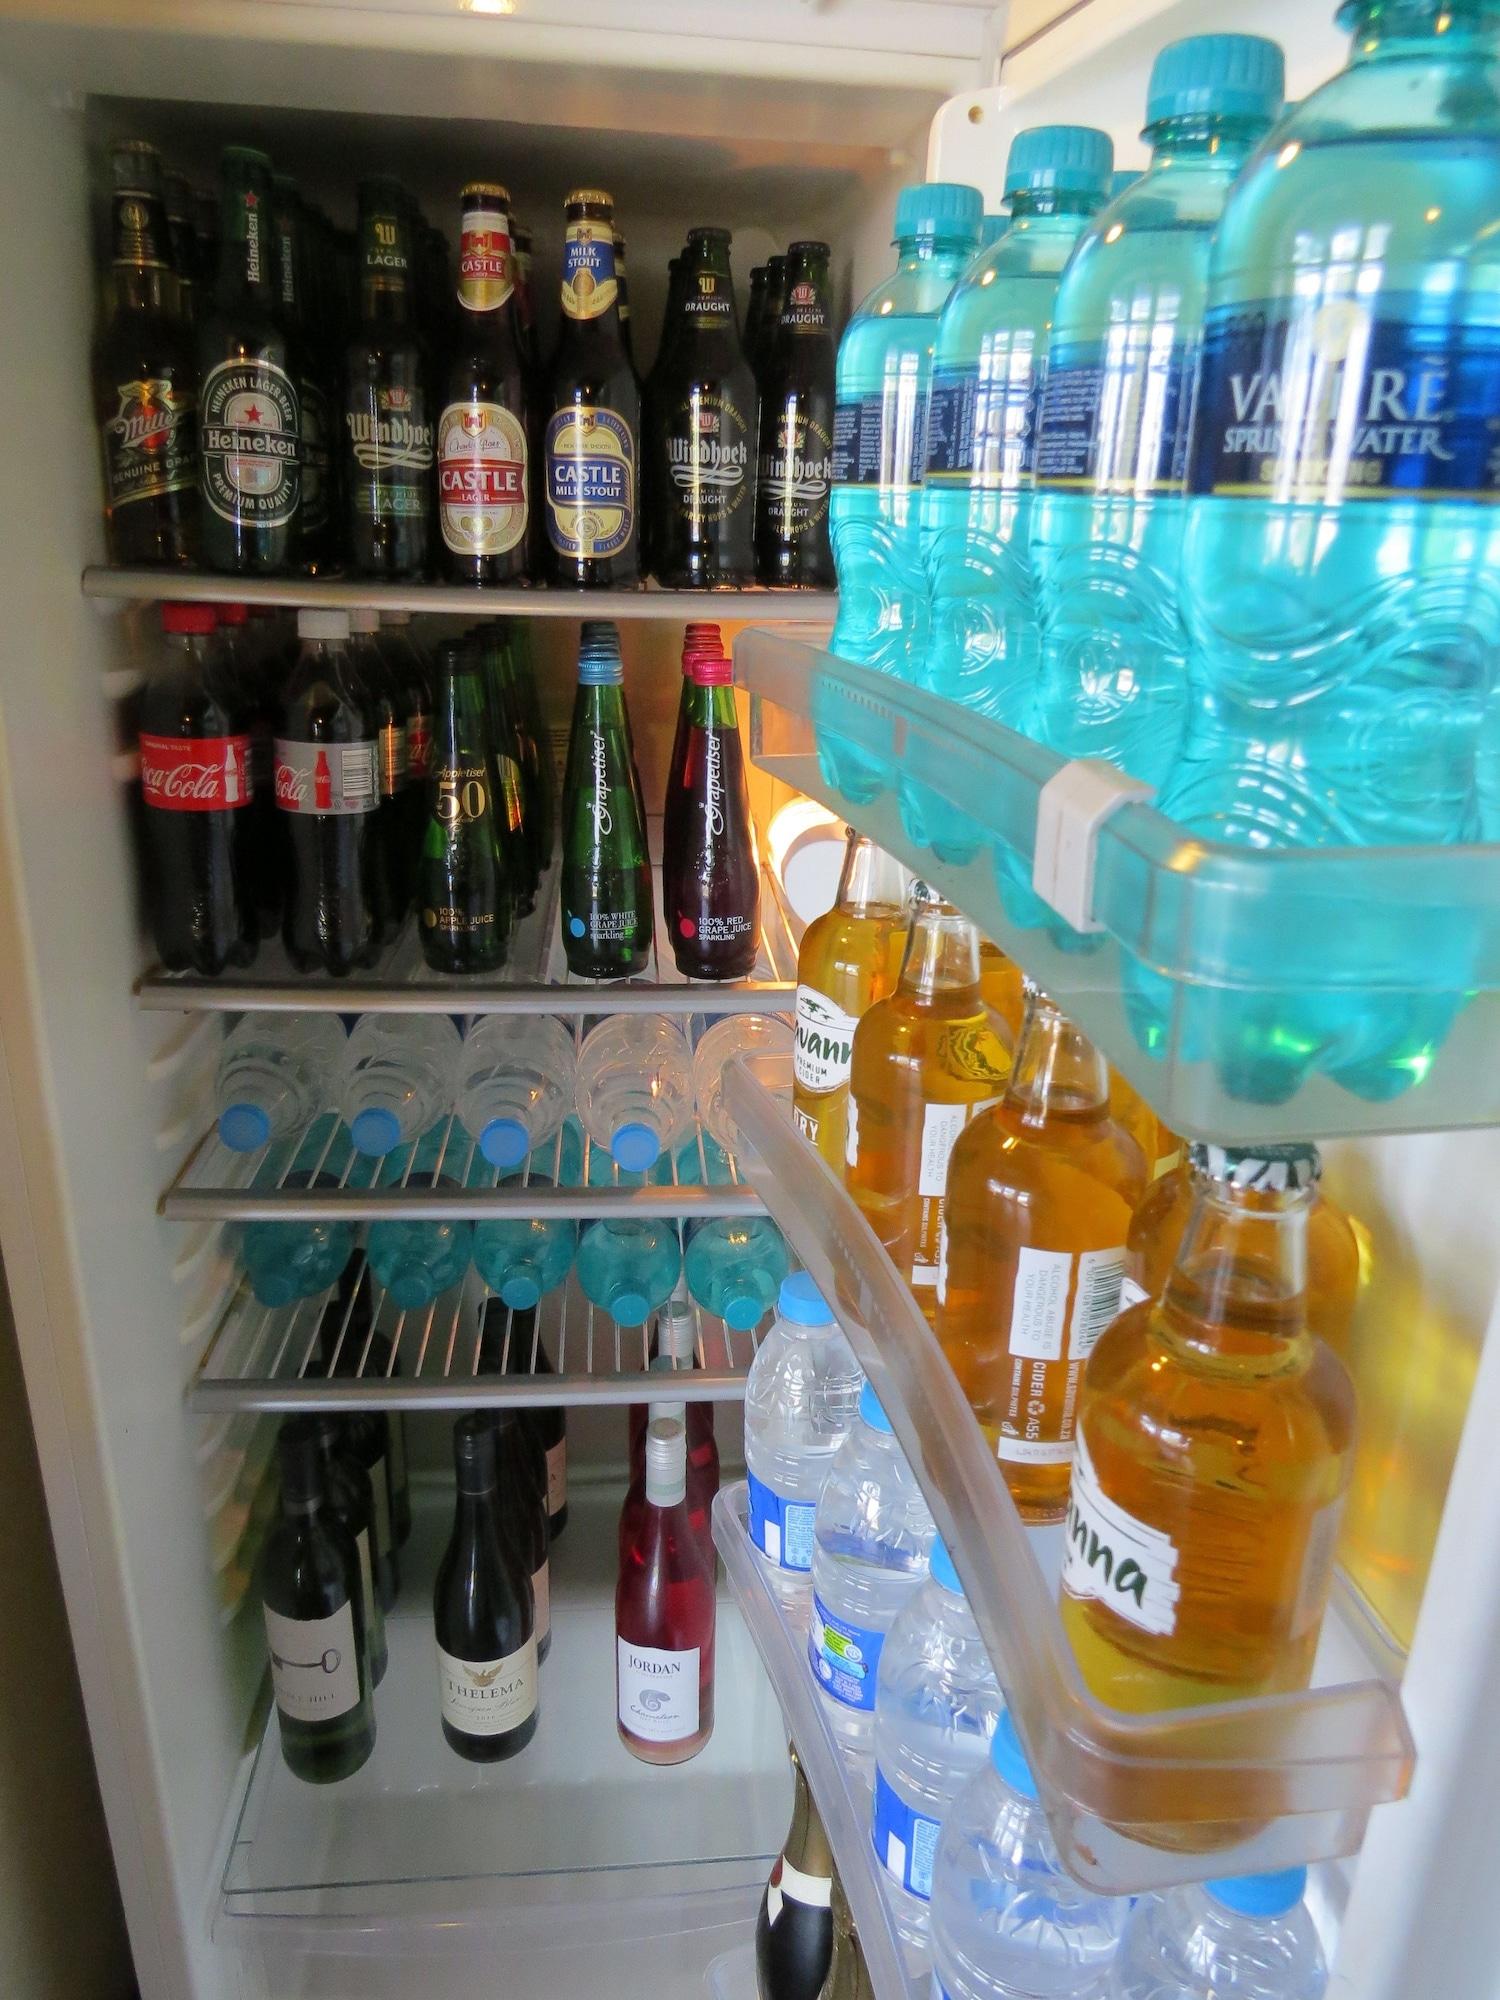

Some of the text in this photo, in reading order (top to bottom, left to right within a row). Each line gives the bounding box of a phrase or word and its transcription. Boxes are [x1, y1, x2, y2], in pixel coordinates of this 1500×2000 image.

[246, 213, 260, 283] Heineken
[570, 247, 597, 258] MILK
[367, 255, 408, 270] LAGER
[461, 259, 503, 273] CASTLE
[567, 257, 601, 269] STOUT
[684, 302, 731, 312] DRAUGHT
[781, 314, 825, 325] DRAUGHT
[1230, 355, 1450, 423] VARÉ
[212, 376, 293, 422] HEINEKEN LAGER BEER
[689, 396, 724, 410] PEMIUM
[777, 413, 810, 427] PRIUM
[346, 412, 434, 452] Windhoe
[1222, 424, 1308, 454] SPRI
[207, 430, 297, 457] Heineken
[554, 465, 622, 485] CASTLE
[759, 454, 832, 484] Winhoek
[441, 470, 519, 493] CASTLE
[212, 473, 294, 511] PREMIUM QUALITY
[461, 492, 492, 503] LAGER
[555, 485, 622, 498] MILK STOUT
[381, 498, 421, 512] AGER
[768, 507, 810, 517] DRAGHT
[436, 780, 487, 820] 50
[470, 913, 495, 926] JUICE
[590, 919, 618, 930] GRAPE
[611, 910, 636, 920] WHITE
[698, 915, 744, 926] 100% RED
[590, 930, 625, 941] sparkling
[698, 921, 753, 935] GRAPE JUICE
[698, 933, 736, 941] SPARKLING
[796, 1054, 828, 1078] PREMIUM
[798, 1066, 821, 1085] CIDER
[793, 1107, 819, 1142] DRY
[1046, 1264, 1060, 1309] ALCOHOL
[1020, 1274, 1036, 1336] YOUR HEALTH
[1035, 1270, 1049, 1327] DANGEROUS
[1043, 1310, 1056, 1341] ABUSE
[1025, 1361, 1047, 1440] CIDER A55
[628, 1654, 681, 1675] JORDAN
[448, 1678, 524, 1699] THELEMA
